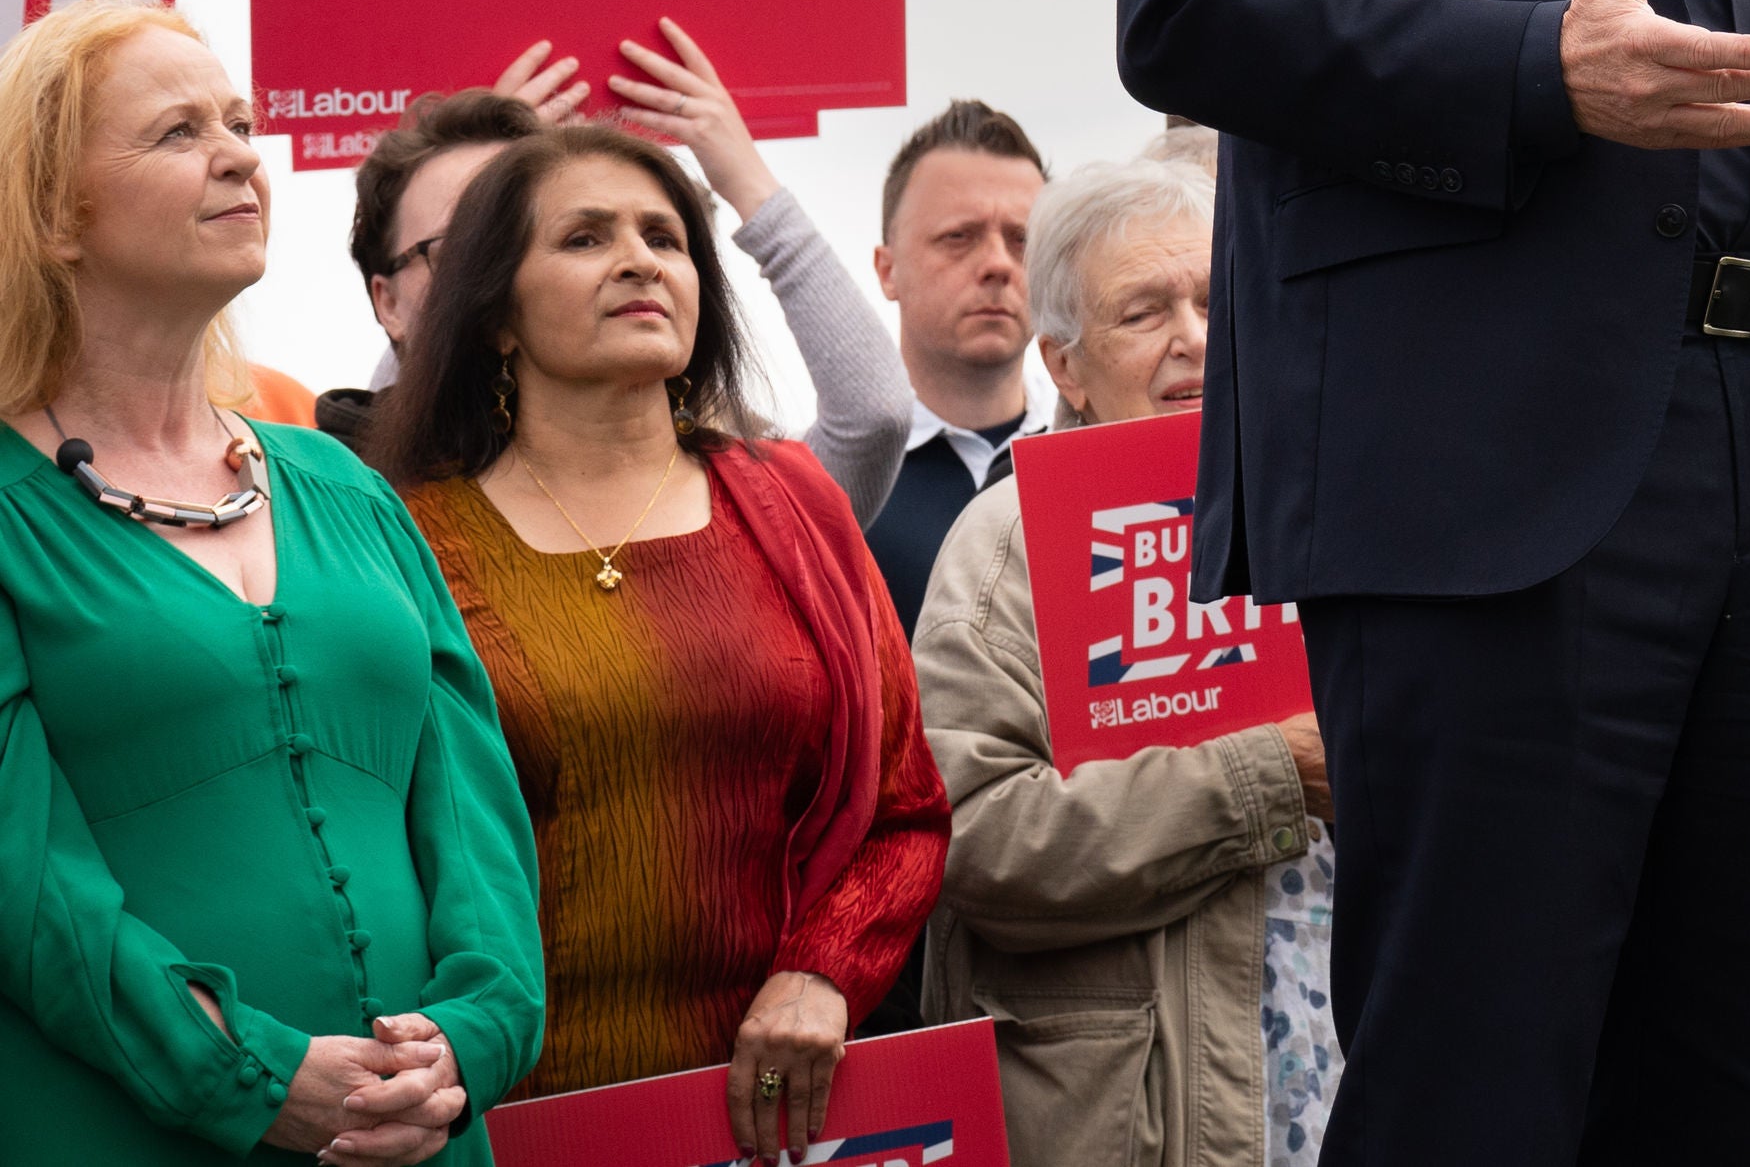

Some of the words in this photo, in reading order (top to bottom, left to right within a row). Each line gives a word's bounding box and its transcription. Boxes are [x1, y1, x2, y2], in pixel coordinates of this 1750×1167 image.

[299, 87, 411, 118] Labour
[1133, 572, 1299, 649] BR
[1118, 686, 1222, 726] Labour
